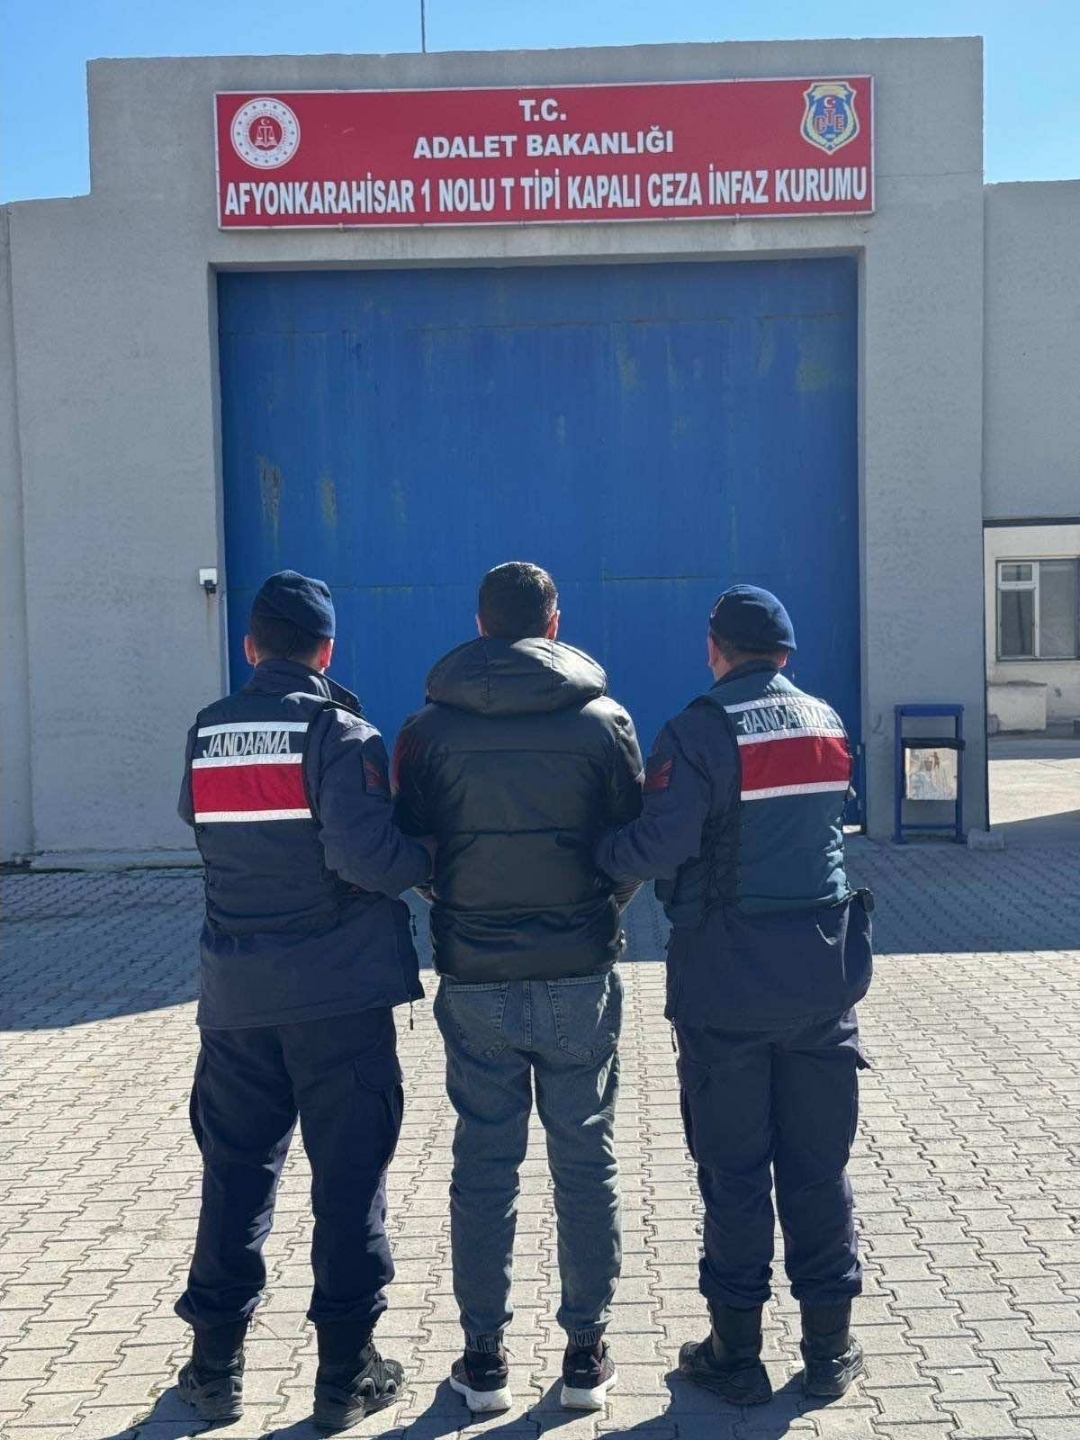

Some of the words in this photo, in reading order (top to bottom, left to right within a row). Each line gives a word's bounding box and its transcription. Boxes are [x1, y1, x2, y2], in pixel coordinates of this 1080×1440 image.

[519, 98, 566, 122] T.C.
[413, 134, 518, 160] ADALET
[526, 125, 674, 157] BAKANLIĞI
[224, 172, 416, 216] AFYONKARAHİSAR
[420, 179, 431, 212] 1
[438, 178, 495, 212] NOLU
[500, 178, 515, 211] T
[520, 168, 560, 210] TİPİ
[567, 174, 640, 210] KAPALI
[647, 172, 702, 207] CEZA
[708, 164, 769, 205] İNFAZ
[775, 166, 866, 203] KURUMU
[742, 704, 836, 734] JANDARMA
[203, 731, 291, 758] JANDARMA
